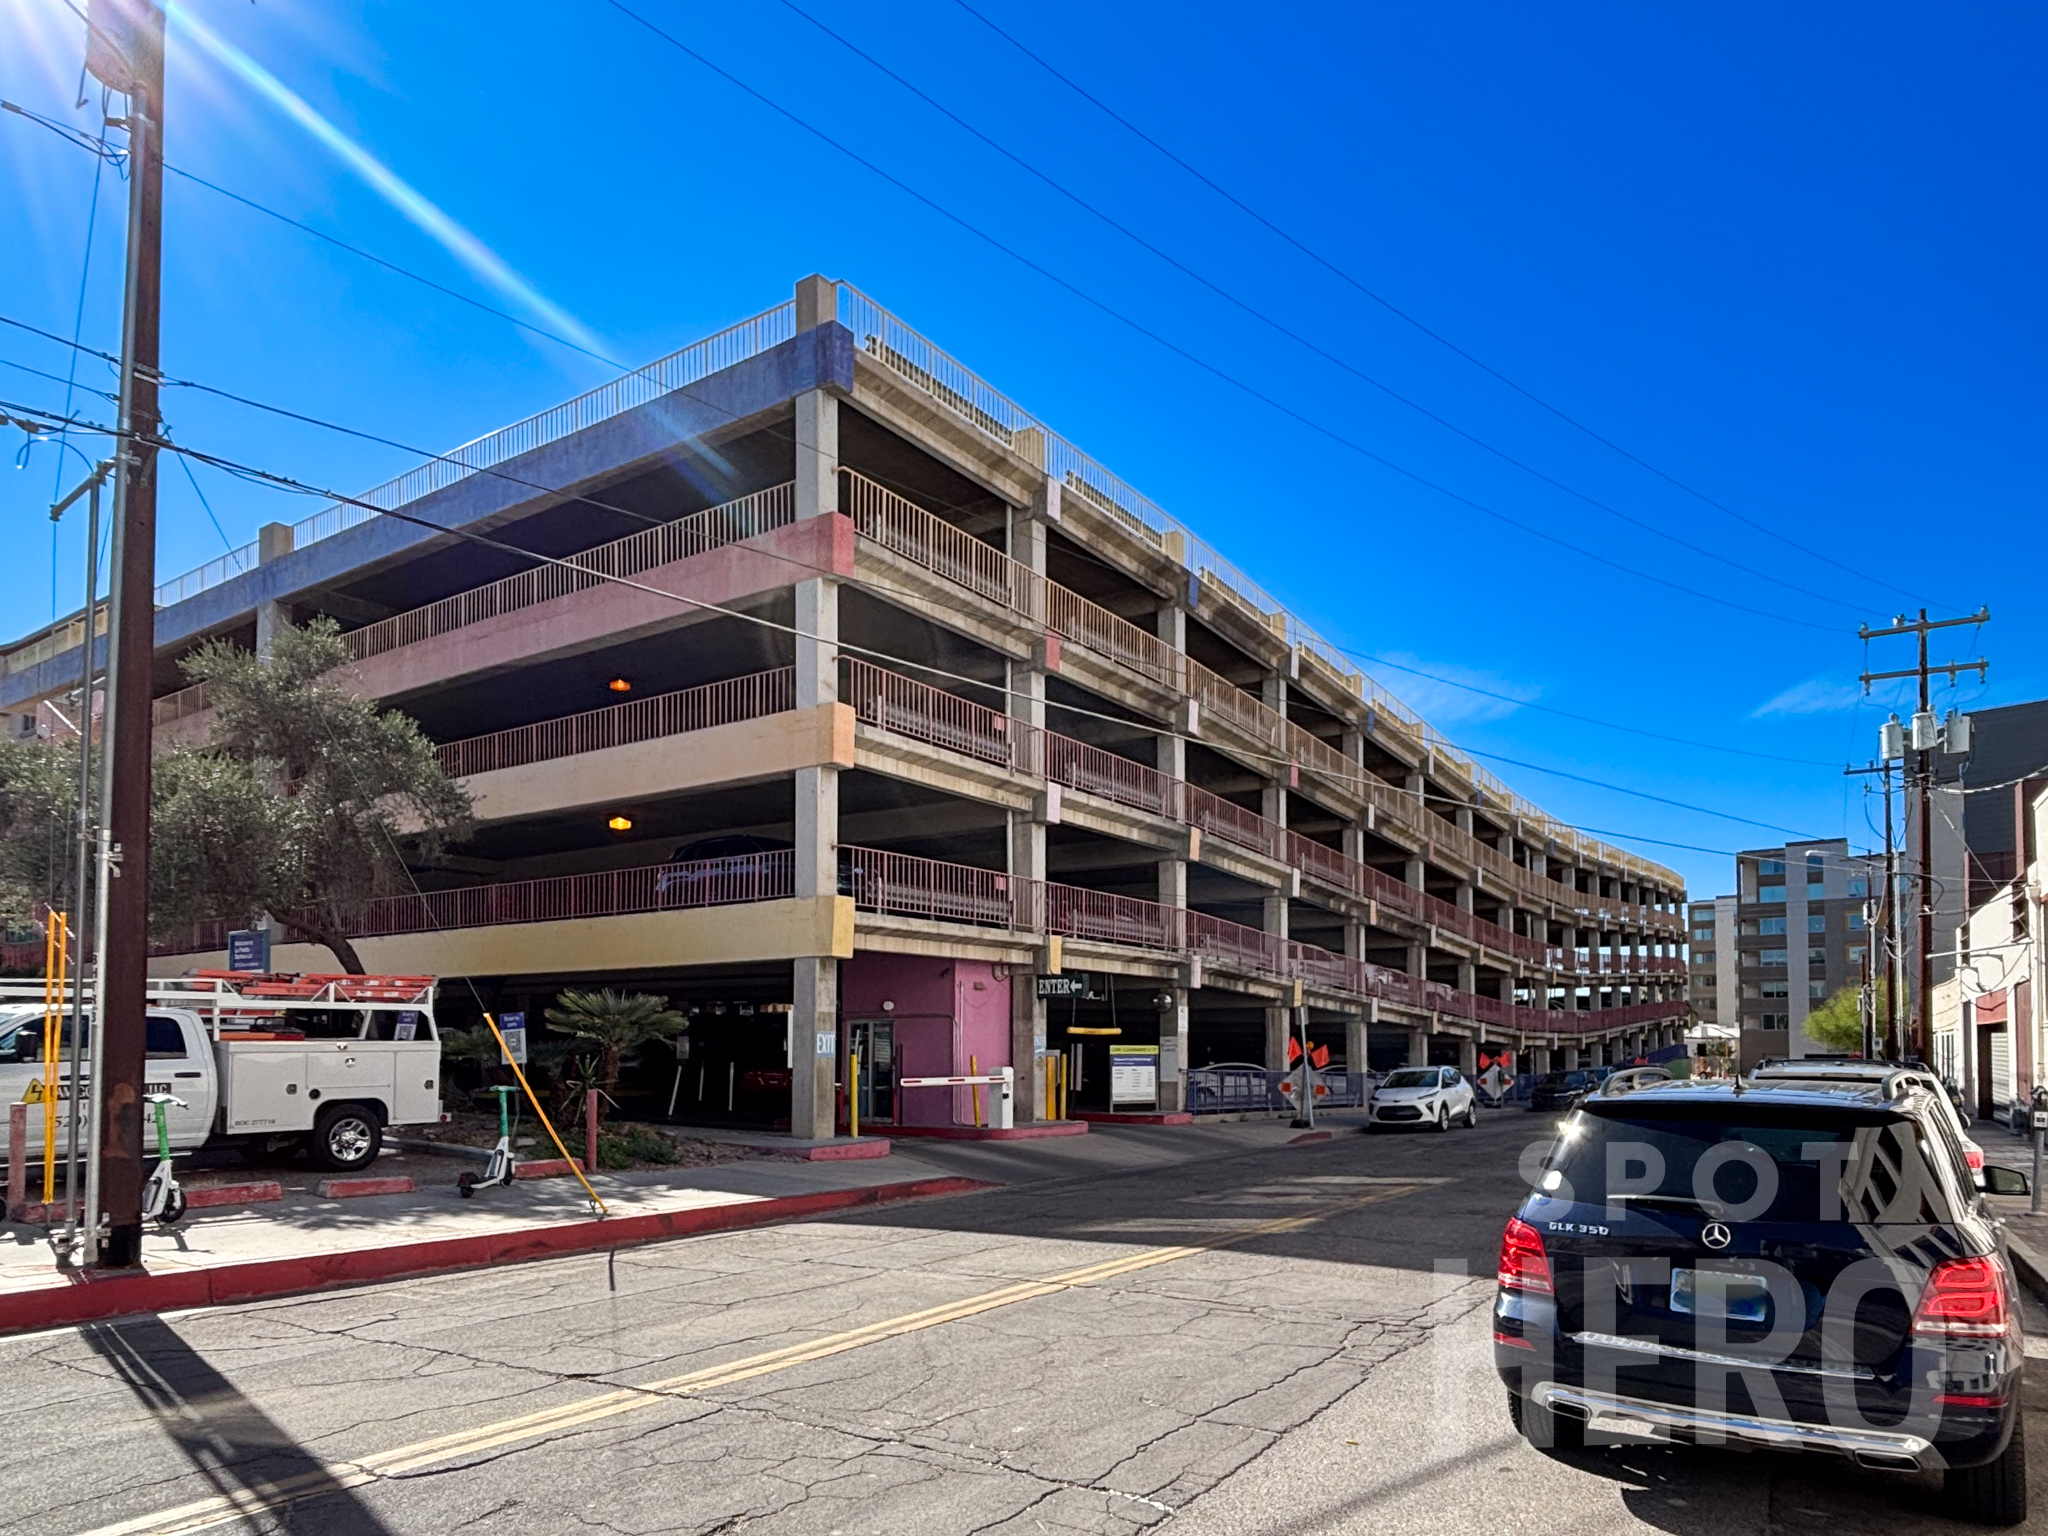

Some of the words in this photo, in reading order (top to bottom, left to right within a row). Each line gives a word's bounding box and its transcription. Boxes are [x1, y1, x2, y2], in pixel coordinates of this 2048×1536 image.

[1038, 978, 1071, 995] ENTER
[816, 1033, 835, 1055] EXIT
[1548, 1221, 1575, 1232] GLK
[1579, 1224, 1610, 1236] 350
